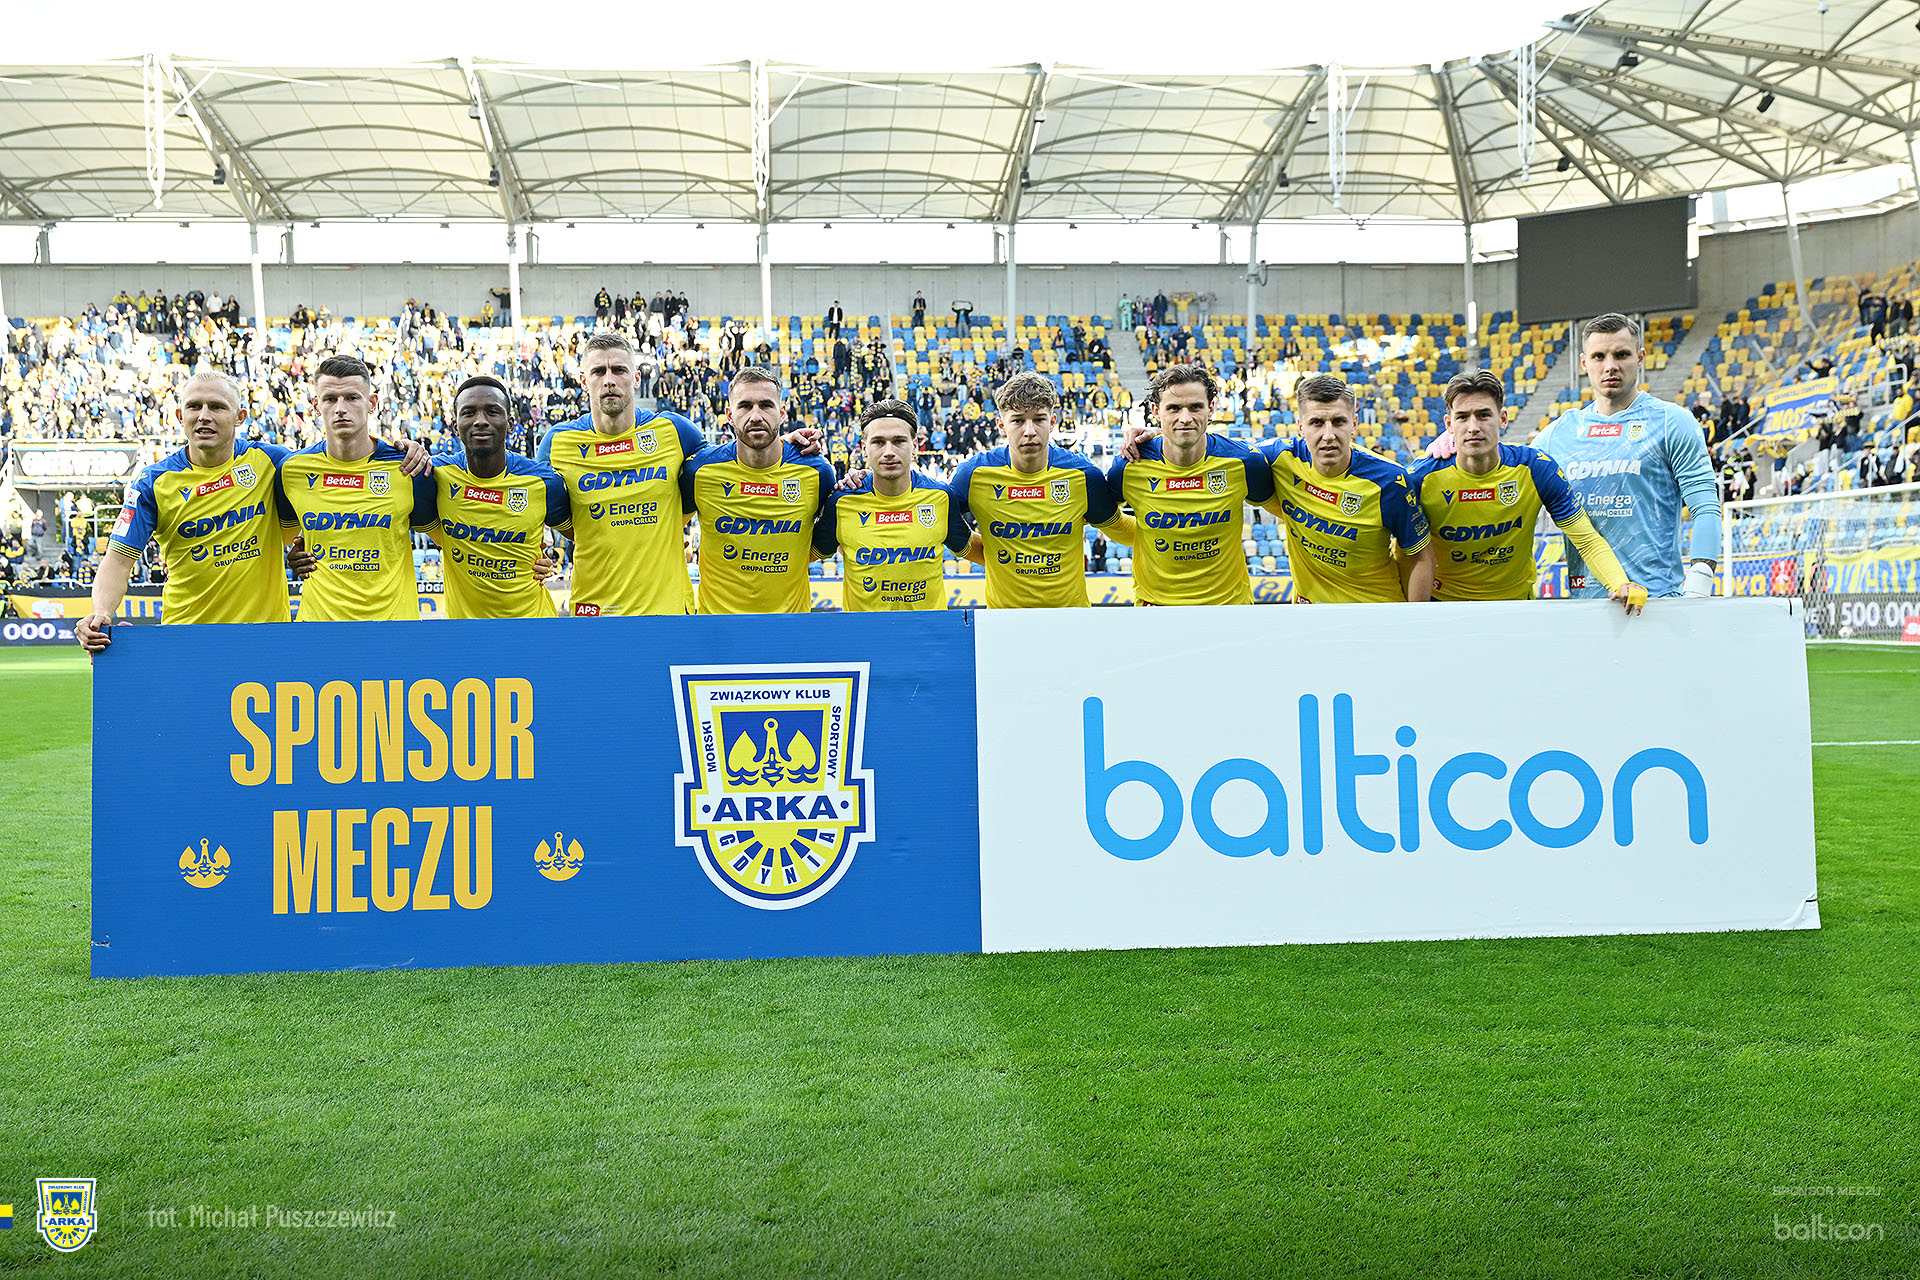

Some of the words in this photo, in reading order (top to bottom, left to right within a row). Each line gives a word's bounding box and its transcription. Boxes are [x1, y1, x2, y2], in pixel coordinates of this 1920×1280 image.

[1590, 426, 1619, 436] Betclic
[598, 442, 631, 455] Betclic
[1566, 460, 1641, 480] GDYNIA
[200, 479, 230, 494] Betclic
[326, 476, 361, 487] Betclic
[578, 466, 668, 492] GDYNIA
[1168, 479, 1201, 489] Betclic
[467, 489, 500, 502] Betclic
[743, 484, 775, 495] Betclic
[1010, 488, 1042, 498] Betclic
[1307, 485, 1335, 502] Betclic
[1461, 491, 1492, 500] Betclic
[609, 502, 657, 516] Energa
[1587, 494, 1631, 508] Energa
[177, 501, 266, 538] GDYNIA
[302, 512, 392, 531] GDYNIA
[611, 519, 633, 527] GRUPA
[635, 516, 657, 525] ORLEN
[715, 516, 802, 535] GDYNIA
[878, 513, 910, 523] Betclic
[1144, 509, 1232, 529] GDYNIA
[1282, 500, 1359, 541] GDYNIA
[442, 519, 527, 543] GDYNIA
[990, 521, 1073, 539] GDYNIA
[1439, 516, 1522, 542] GDYNIA
[213, 535, 257, 557] Energa
[1173, 538, 1219, 551] Energa
[1301, 536, 1347, 559] Energa
[329, 546, 380, 562] Energa
[742, 549, 789, 565] Energa
[856, 546, 936, 566] GDYNIA
[1015, 552, 1062, 566] Energa
[1197, 549, 1220, 559] ORLEN
[468, 554, 517, 571] Energa
[764, 565, 787, 573] ORLEN
[1039, 566, 1060, 574] ORLEN
[468, 570, 491, 578] GRUPA
[881, 580, 927, 593] Energa
[904, 593, 926, 602] ORLEN
[577, 605, 598, 615] APS
[1840, 602, 1880, 627] 500
[3, 623, 56, 640] 000
[710, 690, 791, 703] ZWIĄZKOWY
[795, 689, 831, 699] KLUB
[230, 677, 534, 786] SPONSOR
[702, 720, 717, 773] MORSKI
[827, 705, 842, 779] SPORTOWY
[1083, 693, 1709, 861] balticon
[712, 795, 838, 822] ARKA
[273, 806, 493, 914] MECZU
[719, 832, 835, 885] GDYNIA
